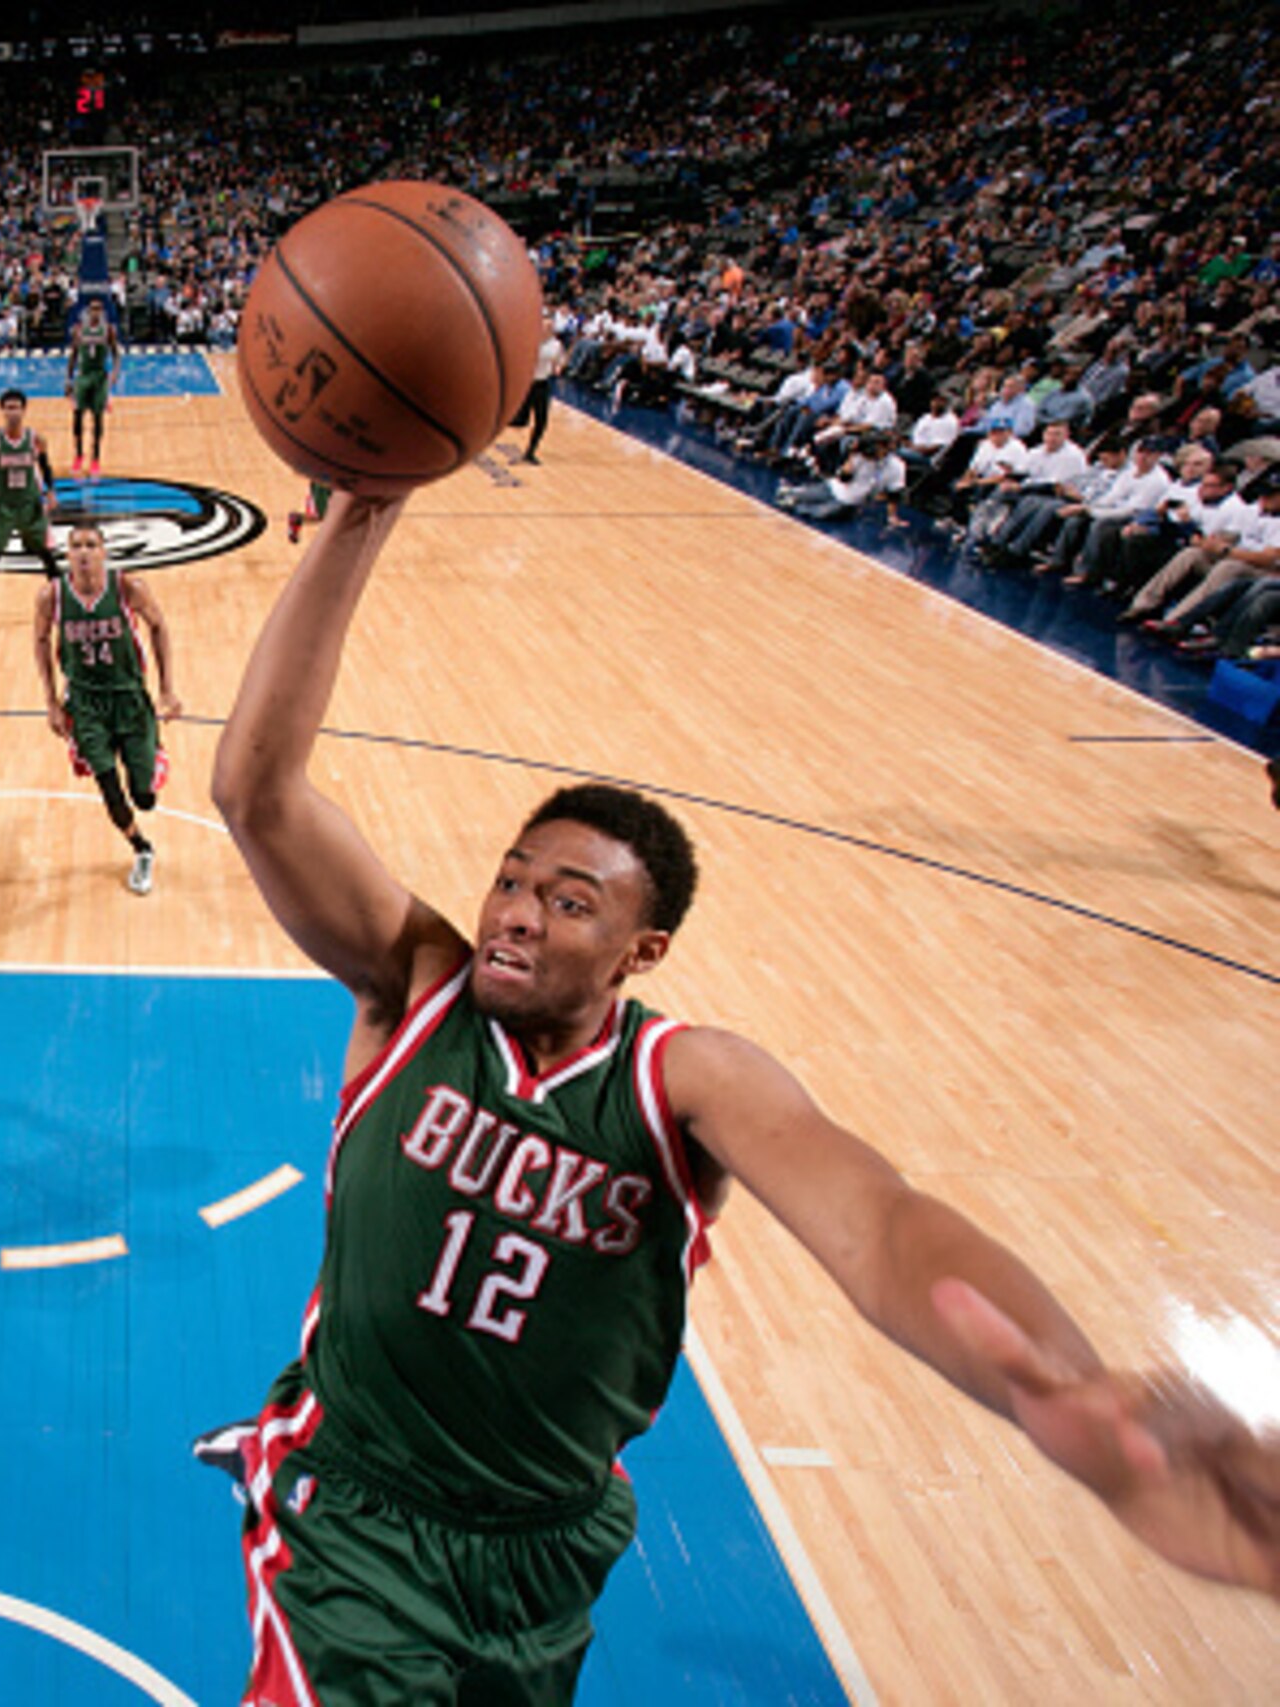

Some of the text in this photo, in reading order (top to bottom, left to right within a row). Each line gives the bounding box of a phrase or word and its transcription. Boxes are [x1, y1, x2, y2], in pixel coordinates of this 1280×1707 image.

[81, 641, 114, 666] 34
[400, 1083, 653, 1258] BUCKS
[417, 1209, 553, 1344] 12
